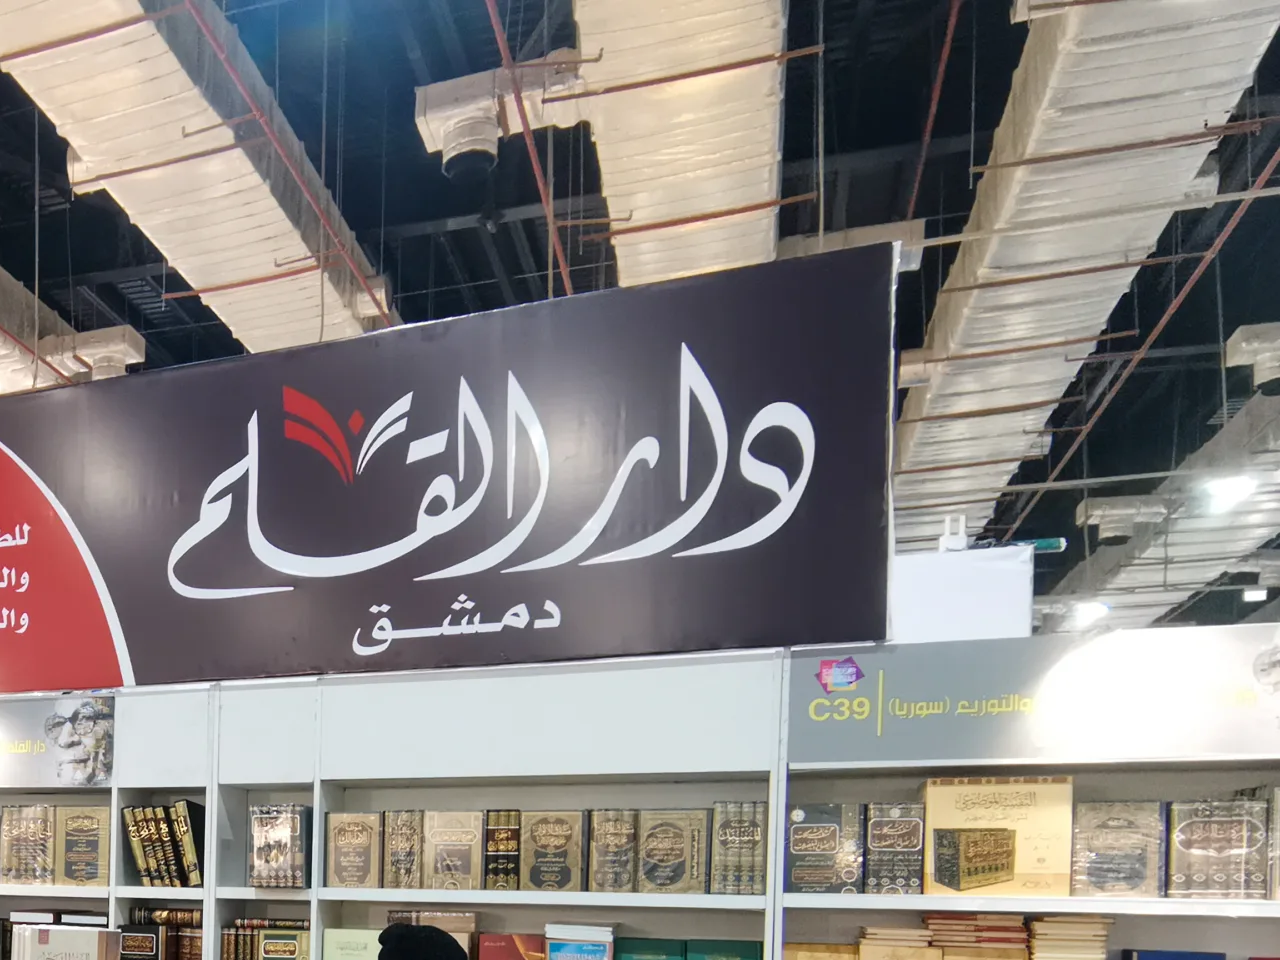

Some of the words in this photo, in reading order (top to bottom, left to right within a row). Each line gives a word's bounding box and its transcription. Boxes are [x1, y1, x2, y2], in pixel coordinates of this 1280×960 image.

[168, 370, 551, 598] القلم
[502, 339, 816, 574] دار
[351, 594, 562, 659] دمشق
[808, 697, 870, 722] C39
[888, 697, 949, 719] (سوريا)
